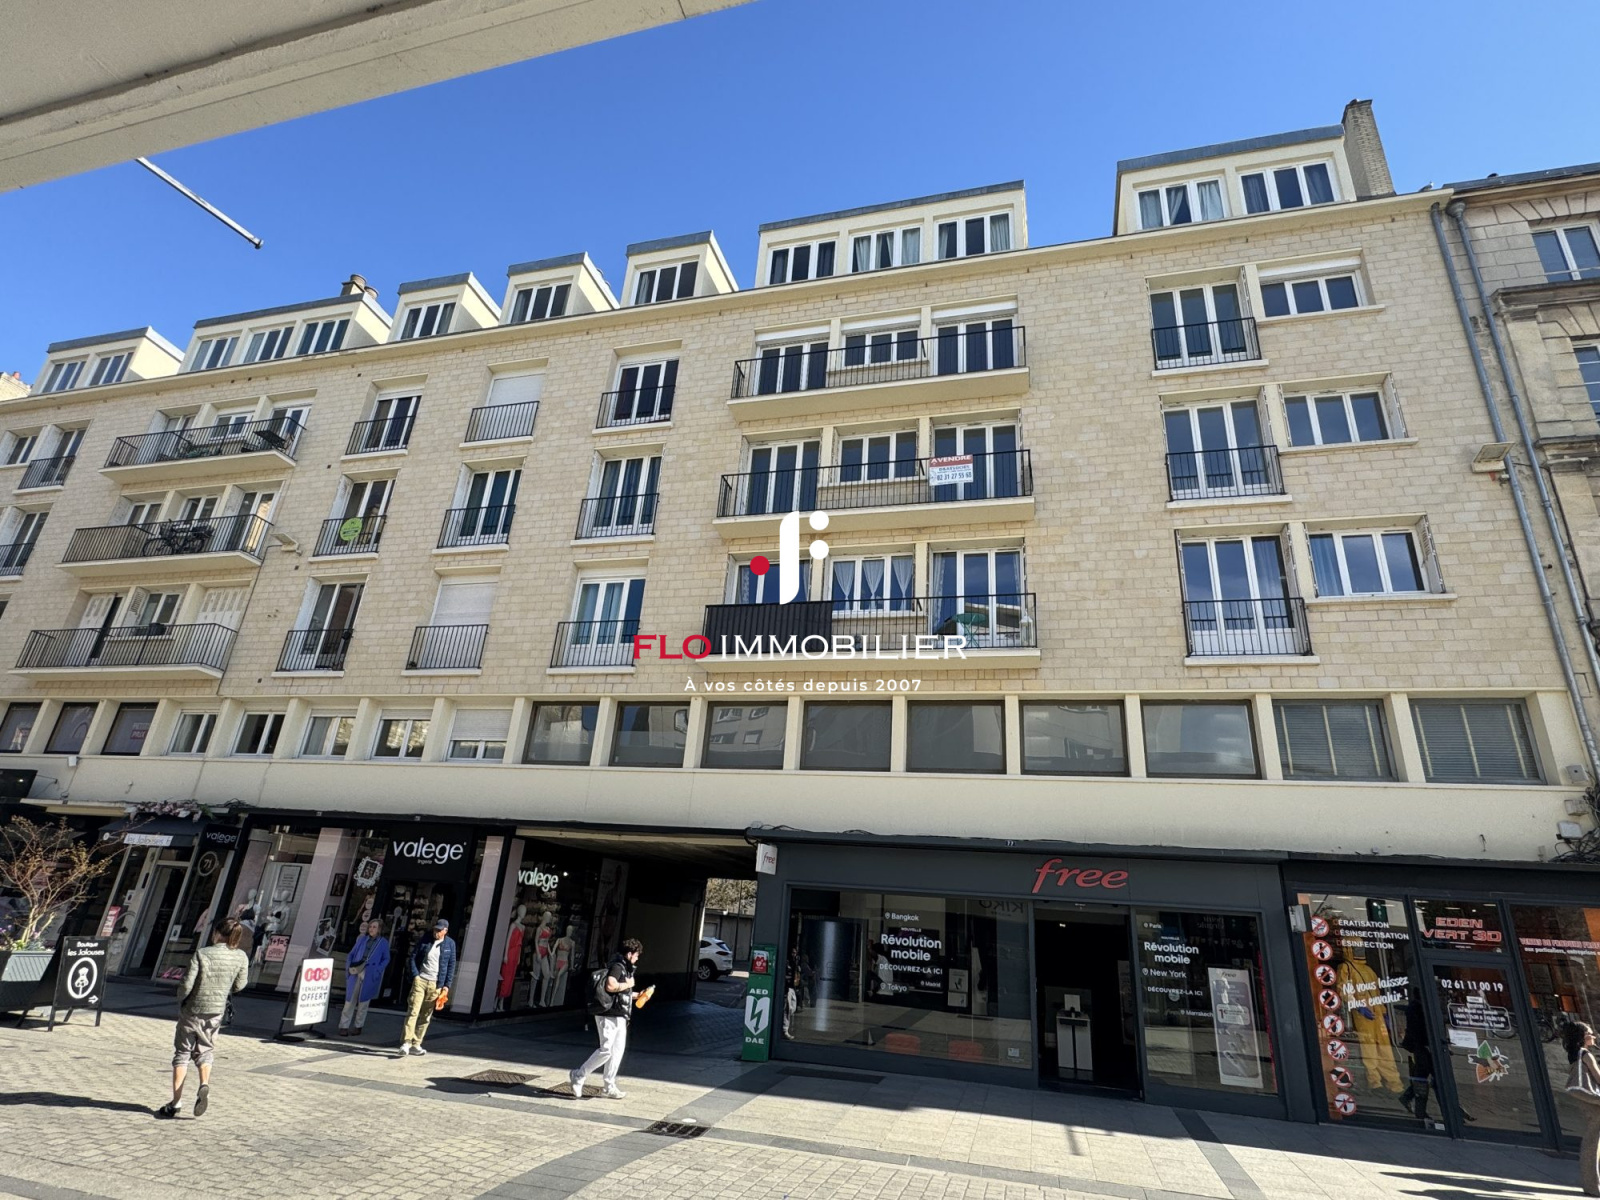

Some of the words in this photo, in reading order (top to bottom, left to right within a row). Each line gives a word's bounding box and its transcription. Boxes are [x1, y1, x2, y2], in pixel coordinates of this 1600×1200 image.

[206, 830, 237, 843] valege
[393, 837, 464, 864] valege
[518, 867, 559, 892] valege
[1032, 858, 1129, 894] free
[891, 913, 919, 922] Bangkok
[1436, 917, 1483, 928] EDEN
[881, 934, 942, 949] Révolution
[1423, 929, 1469, 940] VERT
[1472, 930, 1502, 942] 3D
[1144, 942, 1199, 954] Révolution
[891, 949, 931, 961] mobile
[1155, 954, 1190, 964] mobile
[880, 963, 932, 974] DÉCOUVREZ-LA
[1150, 969, 1167, 977] New
[1169, 970, 1186, 978] York
[887, 983, 907, 992] Tokyo
[1343, 982, 1355, 996] Ne
[1356, 981, 1376, 992] vous
[1378, 976, 1409, 989] laissez
[1442, 979, 1452, 988] 02
[1455, 980, 1464, 989] 61
[1467, 981, 1477, 989] 11
[1480, 982, 1490, 991] 00
[1493, 982, 1503, 992] 19
[301, 993, 327, 1001] OFFERT
[1348, 996, 1367, 1012] plus
[1369, 991, 1402, 1006] envahir
